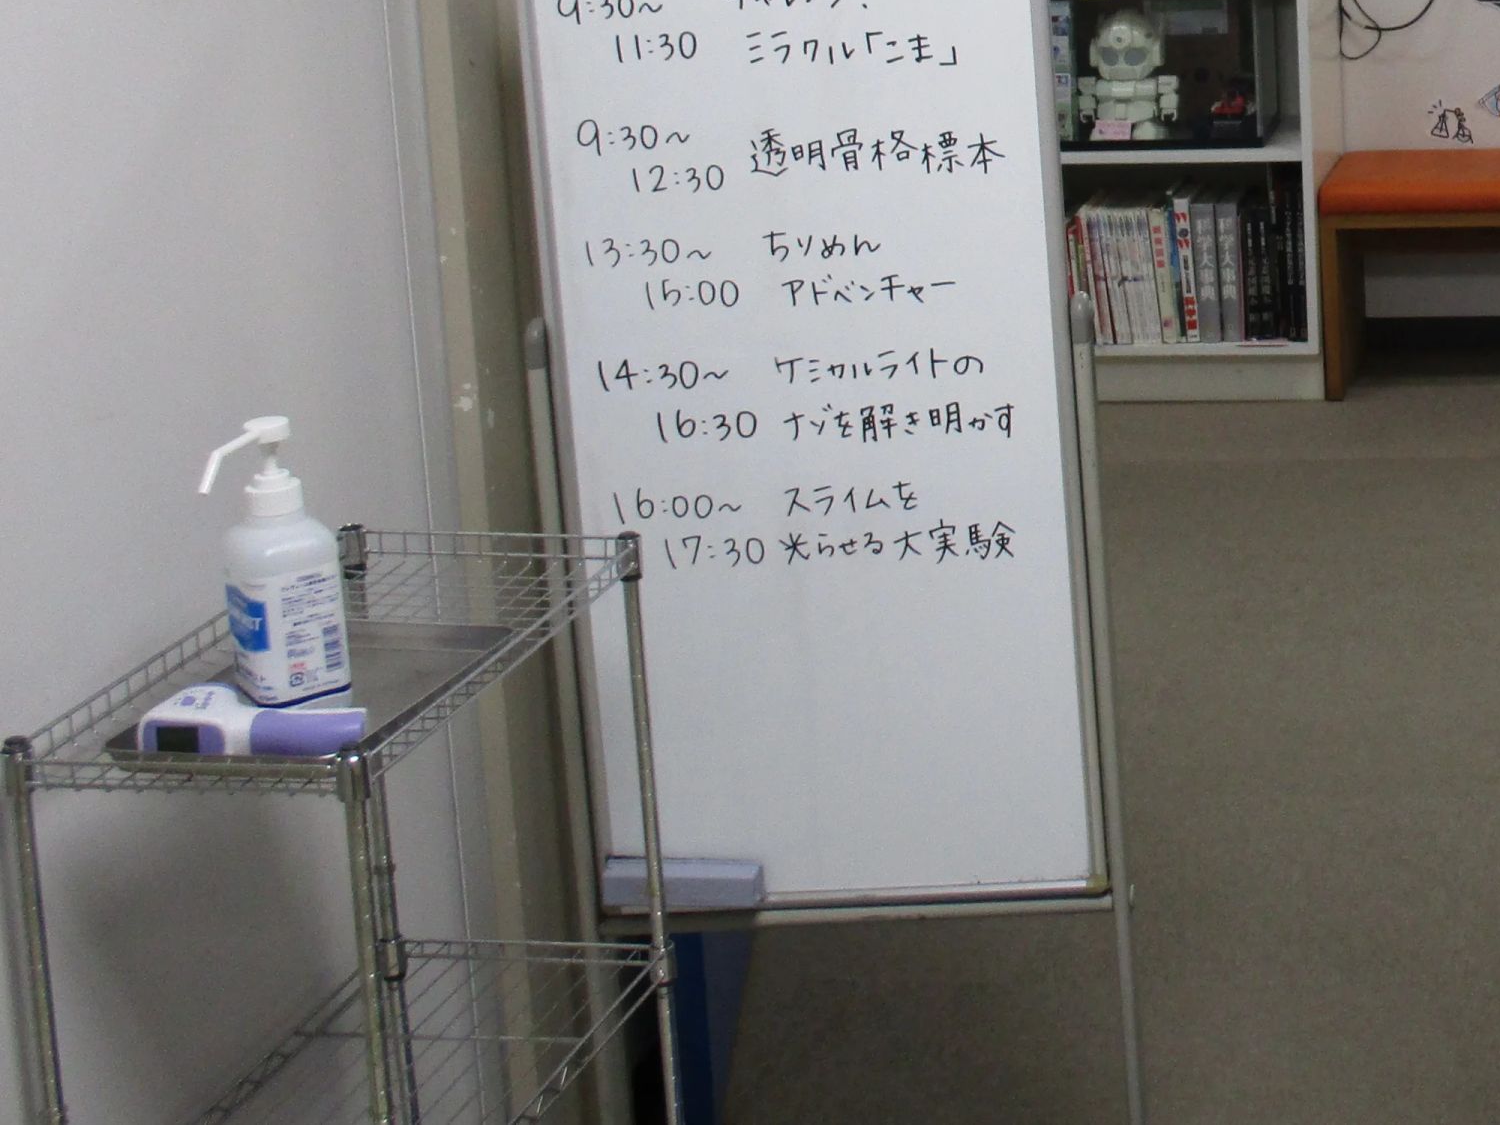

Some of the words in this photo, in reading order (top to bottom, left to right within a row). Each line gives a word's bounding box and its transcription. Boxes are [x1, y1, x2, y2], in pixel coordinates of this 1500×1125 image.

[615, 31, 698, 61] 11:30
[746, 30, 958, 66] ミラクル「こま」
[633, 165, 725, 193] 12:30
[750, 127, 1005, 177] 透明骨格標本
[762, 231, 881, 263] ちりめん
[646, 280, 740, 309] 15:00
[782, 274, 957, 307] アドベンチャー
[775, 349, 984, 384] ケミカルライトの
[657, 410, 757, 443] 16:30
[783, 402, 1016, 443] ナゾを解き明かす
[786, 480, 919, 517] スライムを
[664, 535, 765, 569] 17:30
[779, 520, 1017, 565] 光らせる大実験
